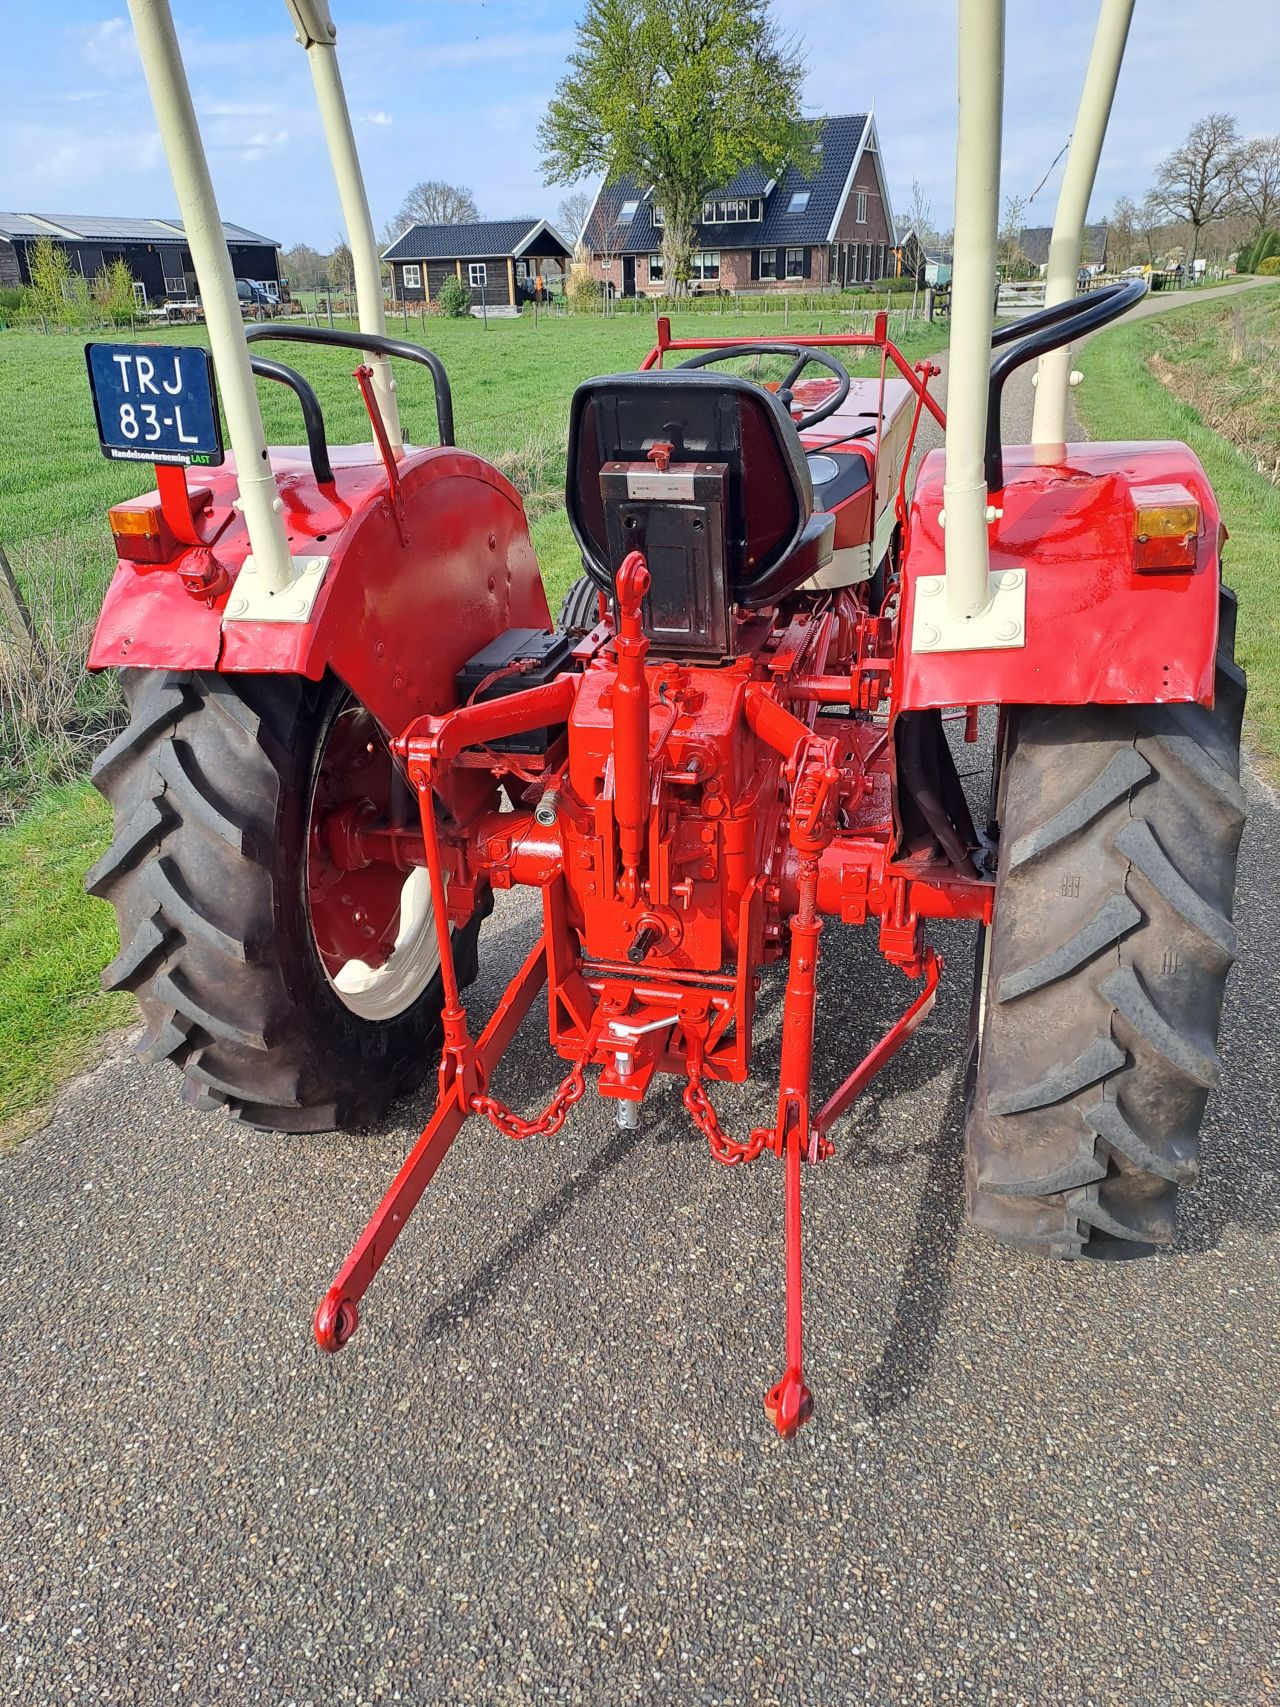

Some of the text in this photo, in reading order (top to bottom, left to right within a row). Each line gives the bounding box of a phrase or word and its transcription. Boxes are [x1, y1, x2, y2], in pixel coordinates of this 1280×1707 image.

[112, 354, 183, 395] TRJ
[119, 403, 199, 444] 83-L
[111, 448, 210, 464] Handelsonderneming LAST
